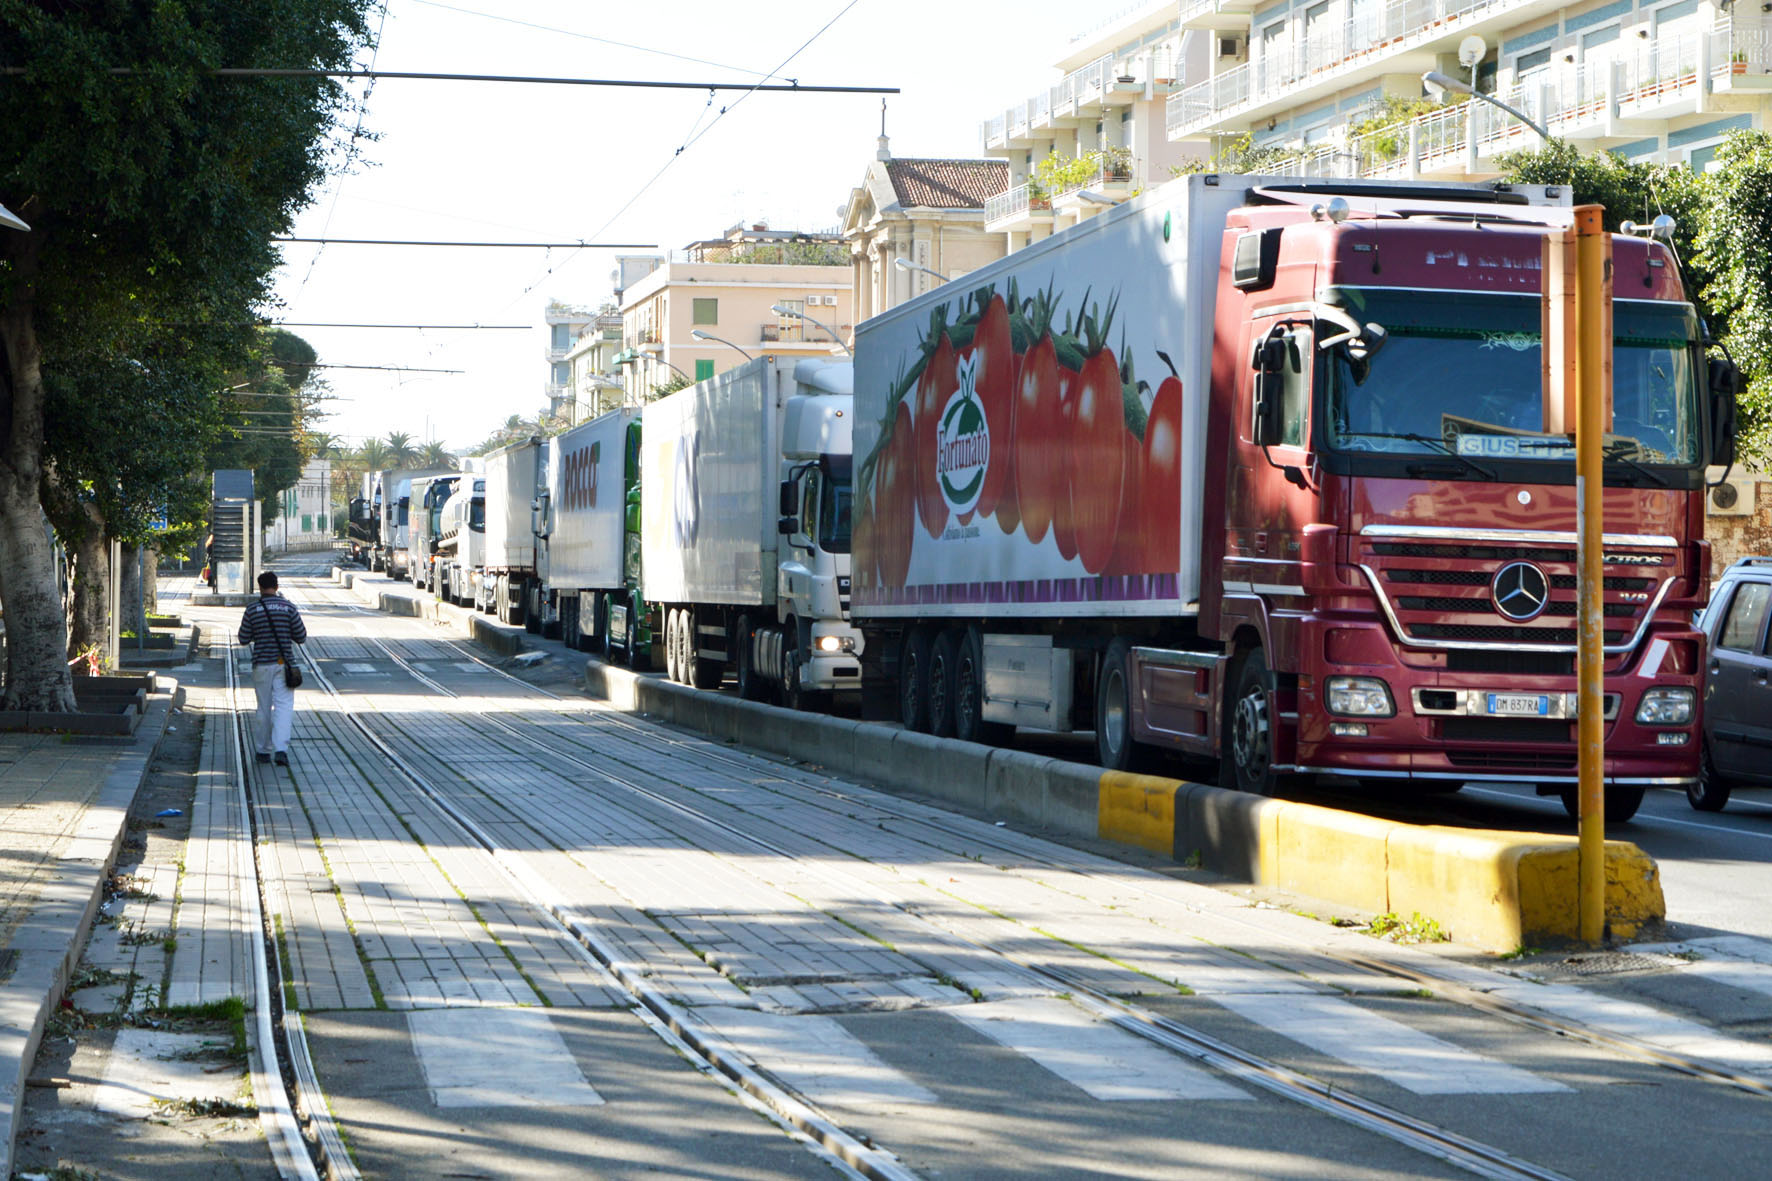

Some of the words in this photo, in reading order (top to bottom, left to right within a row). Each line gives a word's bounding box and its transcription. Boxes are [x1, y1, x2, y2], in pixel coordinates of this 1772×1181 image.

[938, 428, 988, 472] Fortunato
[564, 443, 597, 512] ROCCO
[1601, 554, 1662, 566] CTROS
